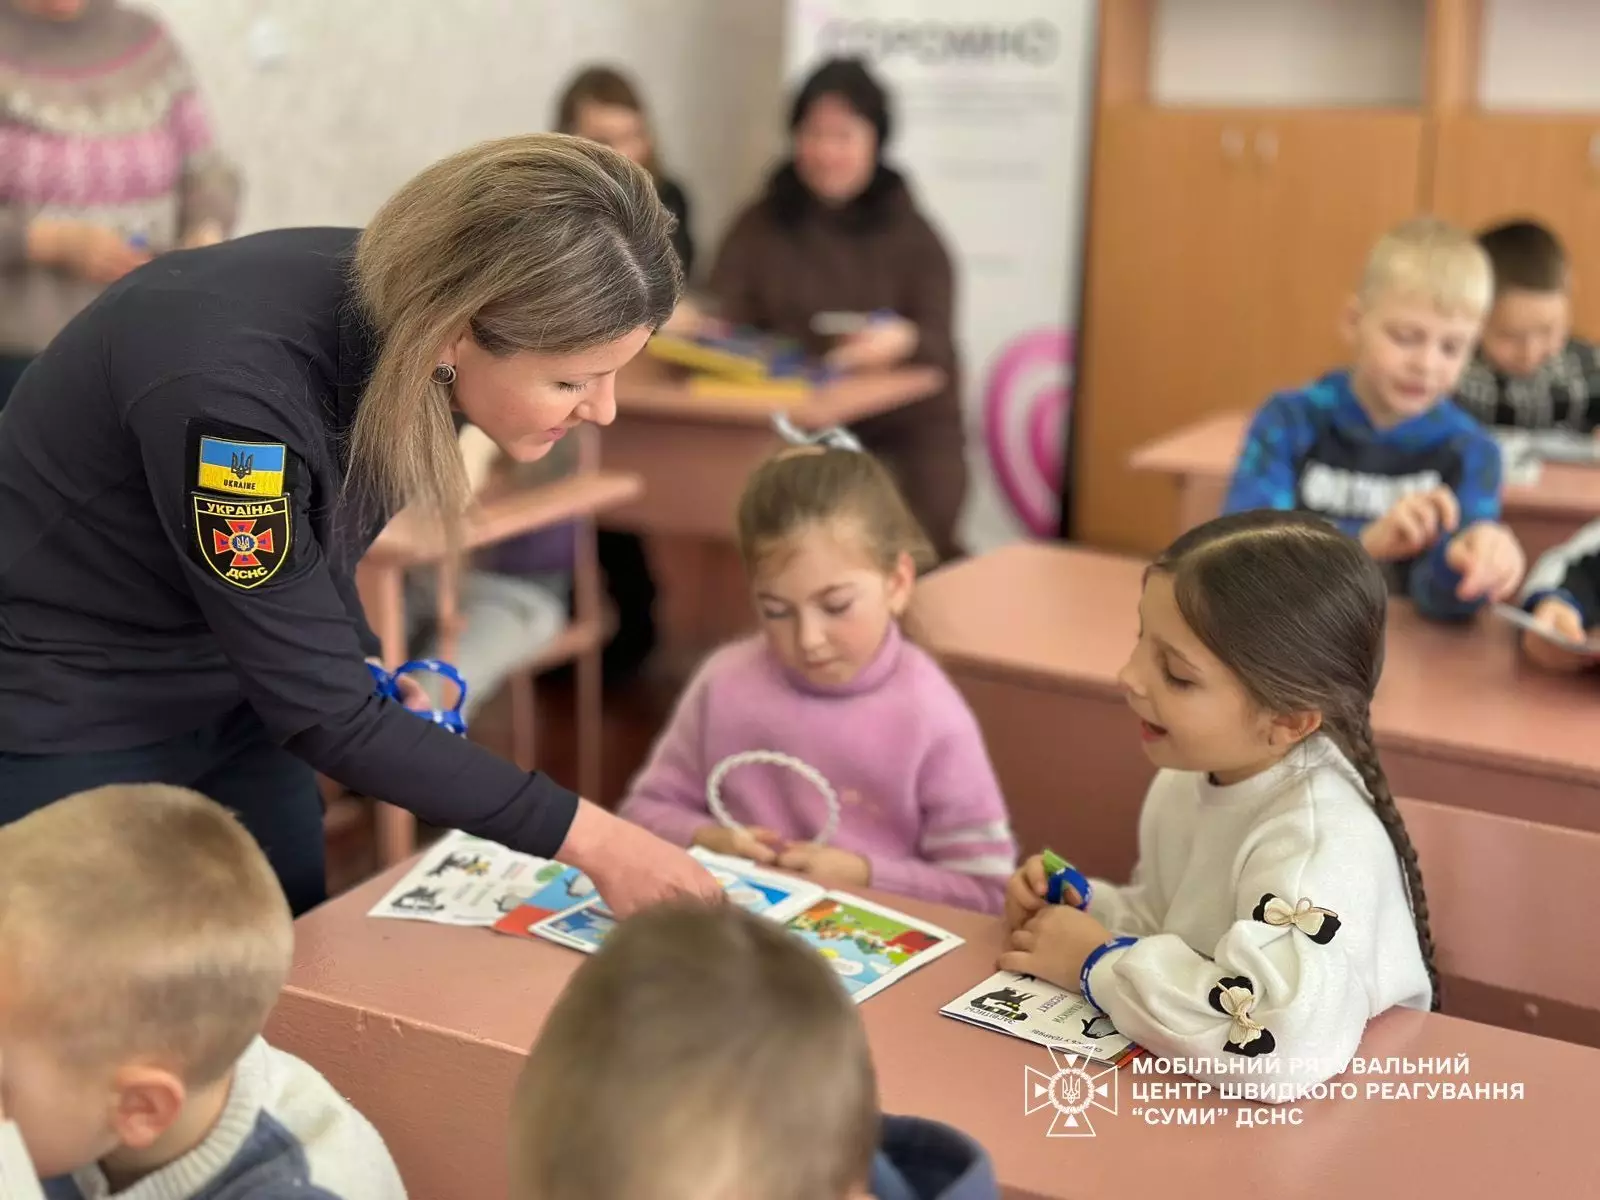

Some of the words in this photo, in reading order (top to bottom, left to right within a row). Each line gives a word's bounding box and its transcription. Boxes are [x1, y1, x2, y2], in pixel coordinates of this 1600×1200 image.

[224, 479, 257, 490] UKRAINE
[206, 502, 274, 515] УКРАЇНА
[225, 566, 269, 580] ДСНС
[1071, 1040, 1103, 1053] СВІТСЬ
